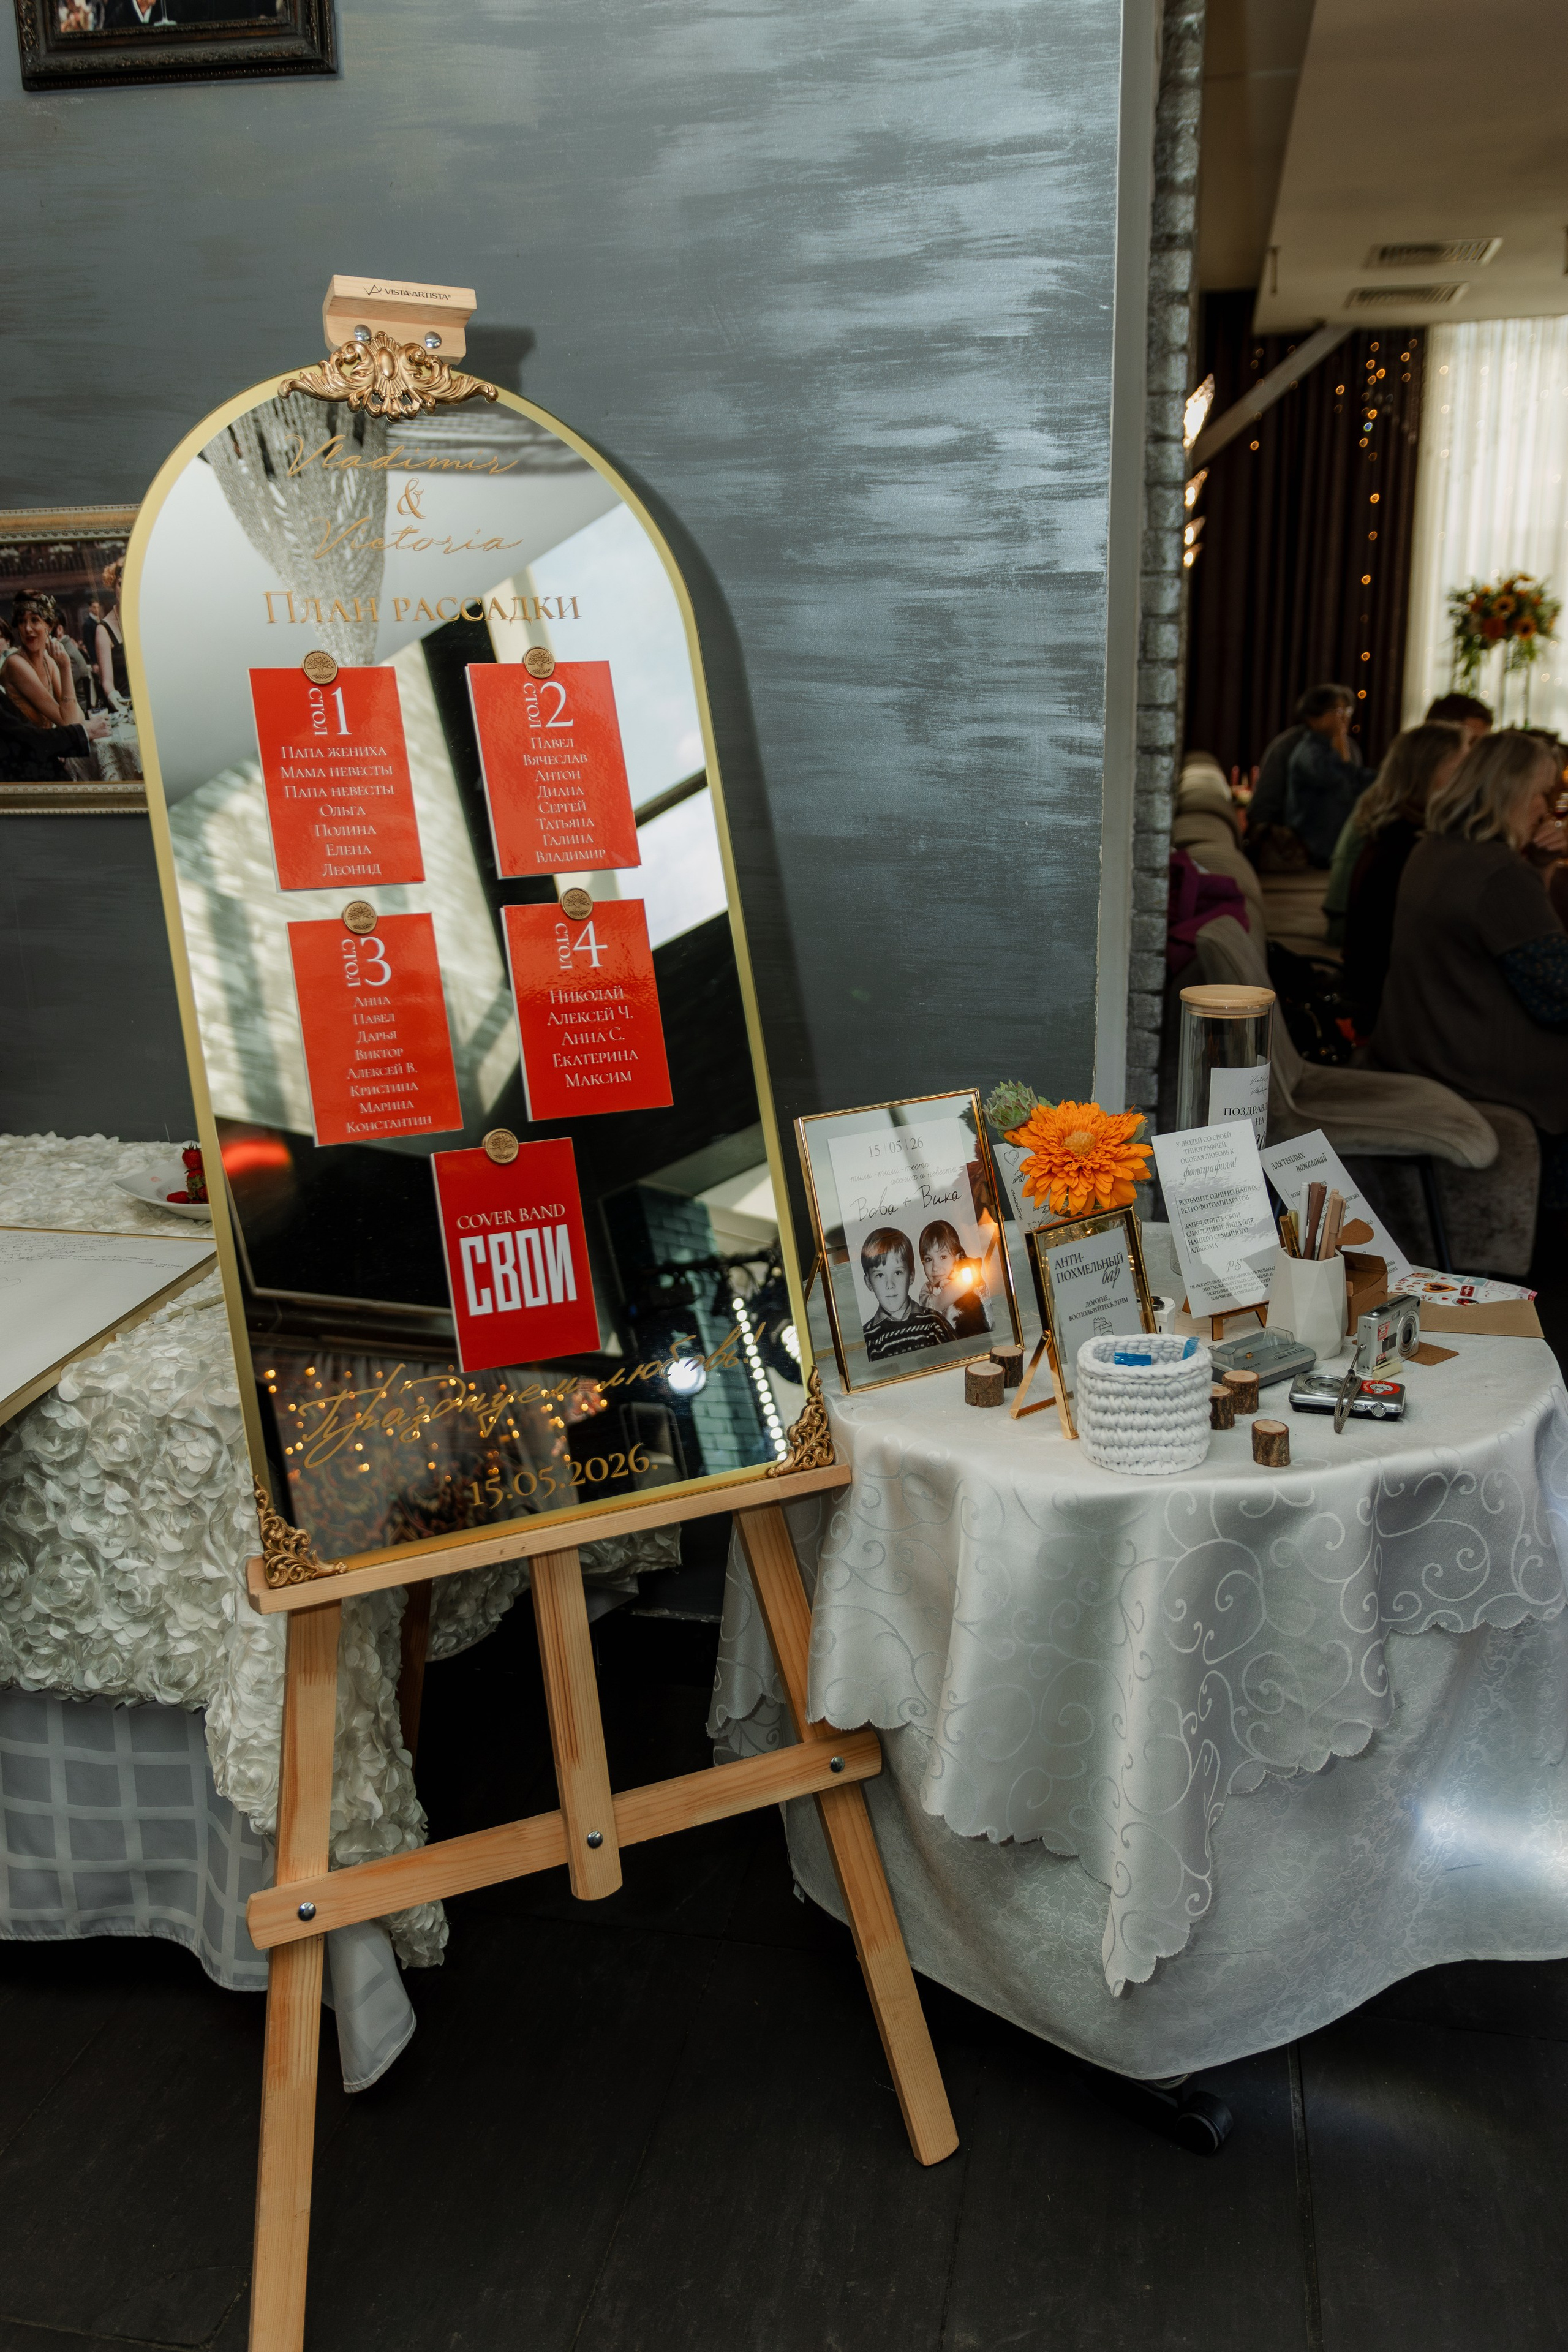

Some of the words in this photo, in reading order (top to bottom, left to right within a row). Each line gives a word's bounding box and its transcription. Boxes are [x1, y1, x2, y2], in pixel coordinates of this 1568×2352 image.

[284, 434, 519, 477] Vladimir
[397, 477, 427, 519] &
[311, 516, 524, 560] Victoria
[331, 687, 352, 735] 1
[540, 681, 573, 728] 2
[573, 920, 608, 968] 4
[360, 937, 392, 986] 3
[617, 1005, 634, 1019] Ч.
[868, 1144, 881, 1157] 15
[889, 1140, 902, 1153] 05
[910, 1136, 924, 1150] 26
[1181, 1137, 1202, 1147] ЛЮДЕЙ
[1213, 1131, 1232, 1140] СВОЕЙ
[1180, 1155, 1205, 1164] ОСОБАЯ
[1205, 1150, 1229, 1159] ЛЮБОВЬ
[1270, 1160, 1283, 1170] ДЛЯ
[1281, 1152, 1306, 1166] ТЕПЛЫХ
[1295, 1152, 1327, 1173] пожеланий
[1182, 1157, 1237, 1185] фотографиям!
[850, 1186, 899, 1221] Вова
[914, 1184, 962, 1208] Вика
[1178, 1194, 1209, 1205] ВОЗЬМИТЕ
[1210, 1191, 1226, 1199] ОДИН
[1180, 1205, 1199, 1214] РЕТРО
[1199, 1195, 1250, 1210] ФОТОАППАРАТОВ
[456, 1210, 516, 1230] COVER
[519, 1204, 565, 1222] BAND
[1184, 1216, 1224, 1229] ЗАПЕЧАТЛИТЕ
[1186, 1224, 1224, 1237] СЧАСТЛИВЫЕ
[1188, 1235, 1213, 1245] НАШЕГО
[1214, 1227, 1249, 1240] СЕМЕЙНОГО
[1190, 1243, 1219, 1254] АЛЬБОМА
[459, 1224, 578, 1317] СВОИ
[1054, 1253, 1084, 1270] АНТИ-
[1056, 1251, 1125, 1283] ПОХМЕЛЬНЫЙ
[1102, 1263, 1120, 1289] бар
[1068, 1302, 1114, 1322] ВОСПОЛЬЗУЙТЕСЬ
[1114, 1297, 1128, 1307] ЭТИМ
[298, 1363, 579, 1468] Празднуем
